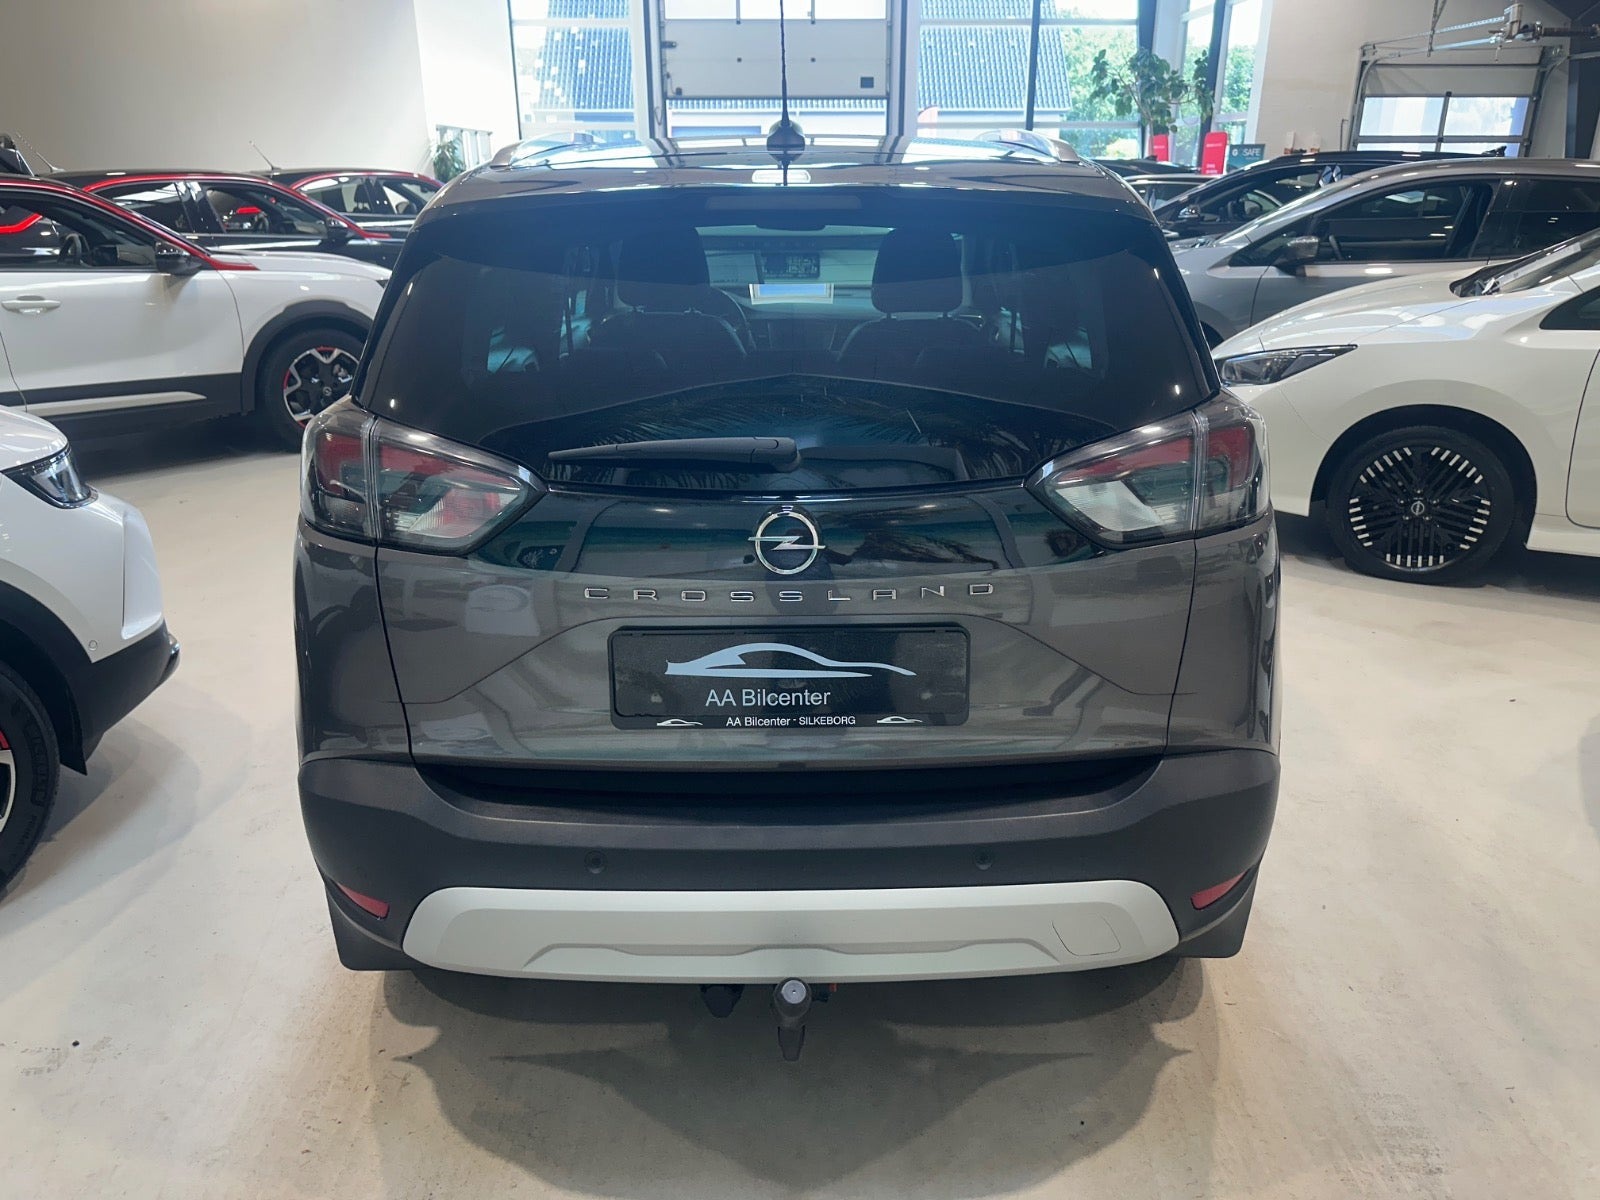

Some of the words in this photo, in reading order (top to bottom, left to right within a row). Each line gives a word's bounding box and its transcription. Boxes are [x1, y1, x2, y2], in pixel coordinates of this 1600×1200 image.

[583, 583, 994, 602] CROSSLAND
[705, 689, 736, 707] AA
[742, 689, 830, 706] Bilcenter
[726, 716, 741, 727] AA
[745, 715, 790, 727] Bilcenter
[799, 715, 855, 726] SILKEBORG
